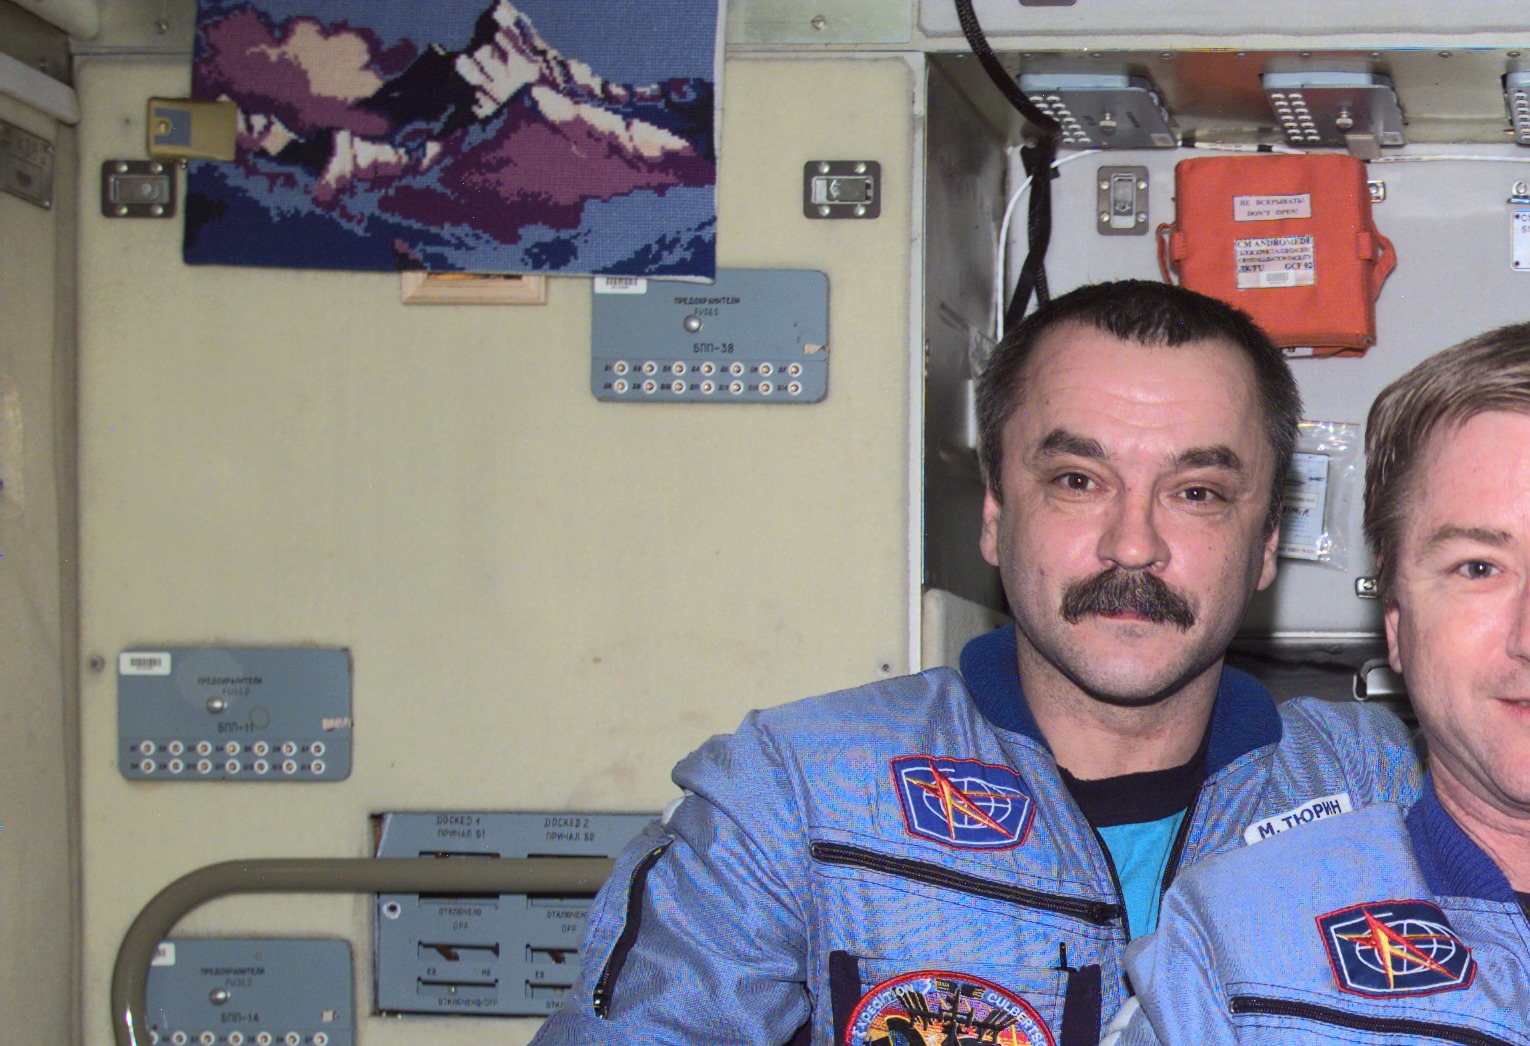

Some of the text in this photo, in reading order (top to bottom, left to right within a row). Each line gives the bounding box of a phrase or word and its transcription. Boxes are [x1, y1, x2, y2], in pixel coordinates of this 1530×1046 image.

[693, 342, 735, 354] БПП-38
[1257, 799, 1343, 839] М. ТЮРИН
